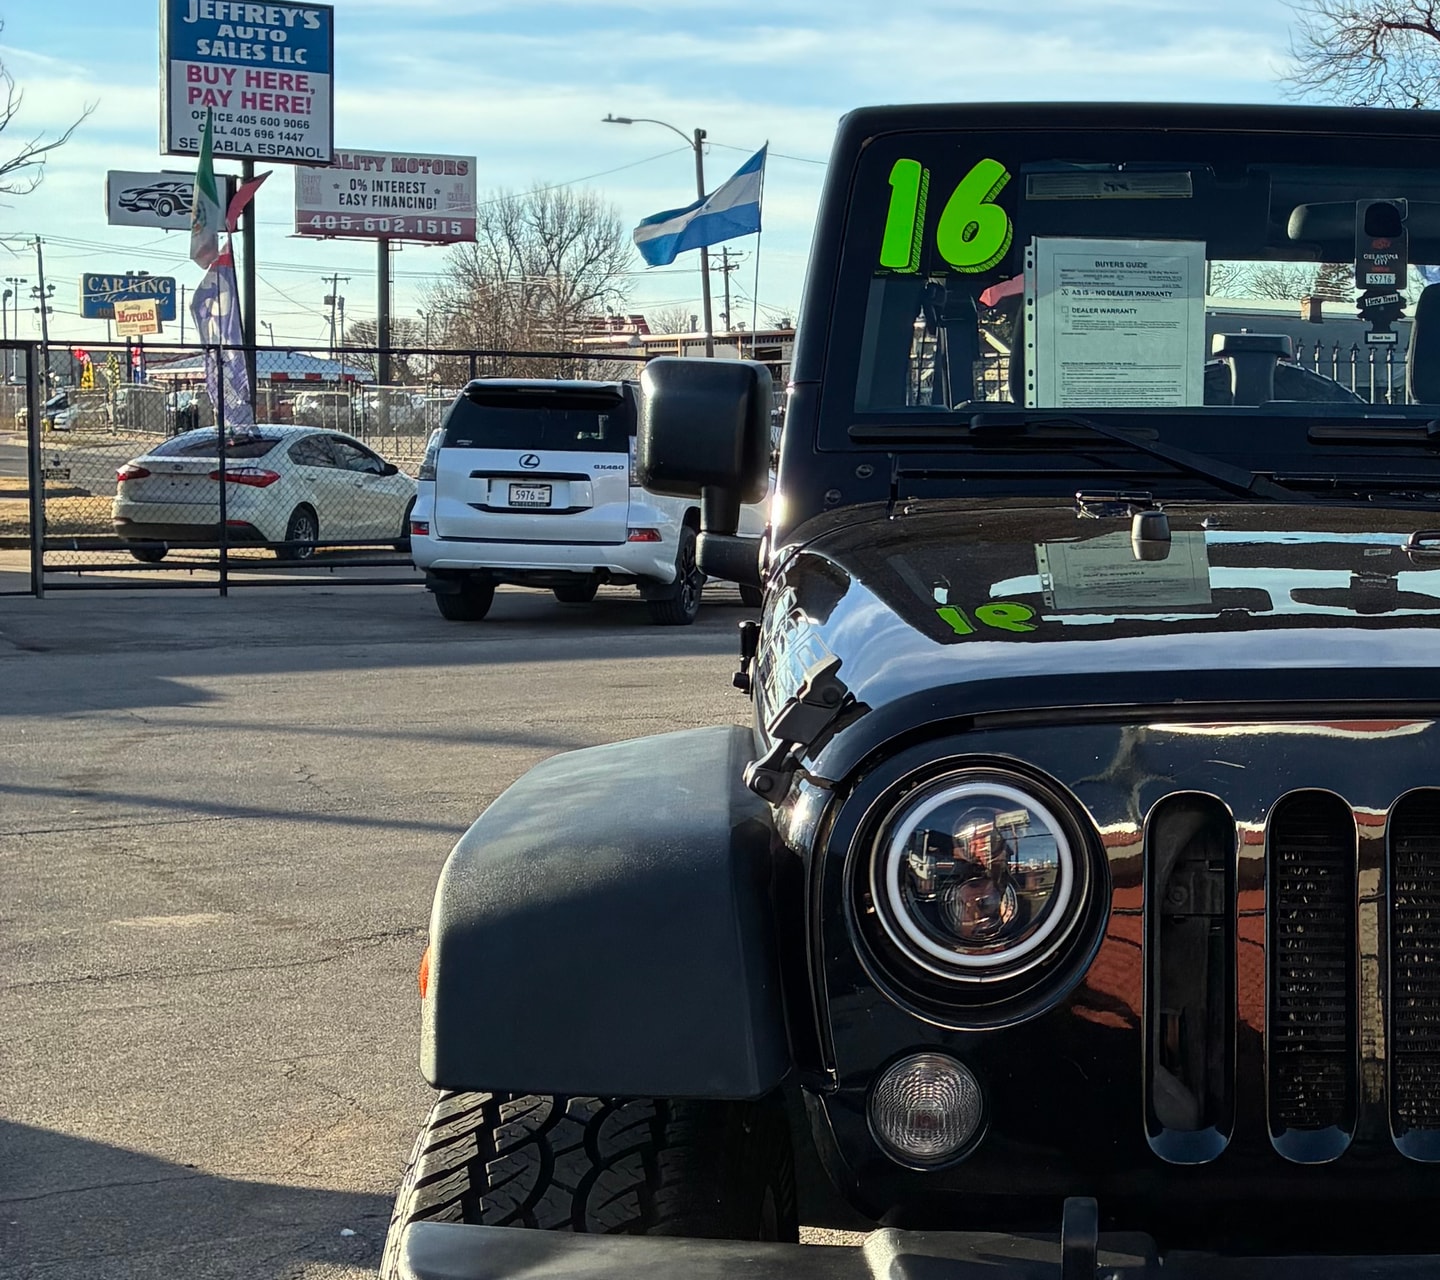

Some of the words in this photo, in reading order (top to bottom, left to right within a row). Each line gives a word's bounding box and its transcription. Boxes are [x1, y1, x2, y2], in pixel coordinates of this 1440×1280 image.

[183, 0, 321, 29] JEFFREY'S
[217, 24, 288, 42] AUTO
[196, 39, 266, 61] SALES
[272, 46, 308, 64] LLC
[186, 64, 237, 86] BUY
[245, 70, 315, 95] HERE,
[188, 86, 233, 108] PAY
[241, 91, 312, 115] HERE!
[191, 110, 233, 123] OFICE
[236, 115, 257, 125] 405
[260, 117, 280, 127] 600
[283, 119, 310, 129] 9066
[198, 124, 227, 135] CLL
[230, 127, 251, 137] 405
[254, 129, 275, 139] 696
[278, 132, 304, 142] 1447
[179, 137, 199, 150] SE
[212, 140, 254, 154] ABLA
[257, 143, 325, 160] ESPANOL
[328, 153, 386, 172] ALITY
[391, 157, 469, 177] MOTORS
[350, 178, 368, 192] 0%
[371, 180, 427, 195] INTEREST
[339, 193, 368, 207] EASY
[371, 195, 437, 210] FINANCING!
[880, 158, 1013, 273] 16
[309, 214, 463, 236] 405.602.1515
[1095, 260, 1125, 268] BUYERS
[1126, 261, 1148, 269] GUIDE
[87, 276, 124, 292] CAR
[128, 278, 171, 294] KING
[1107, 289, 1134, 297] DEALER
[1135, 290, 1173, 298] WARRANTY
[117, 309, 155, 323] MOTORS
[1100, 307, 1138, 315] WARRANTY
[515, 490, 535, 501] 5976
